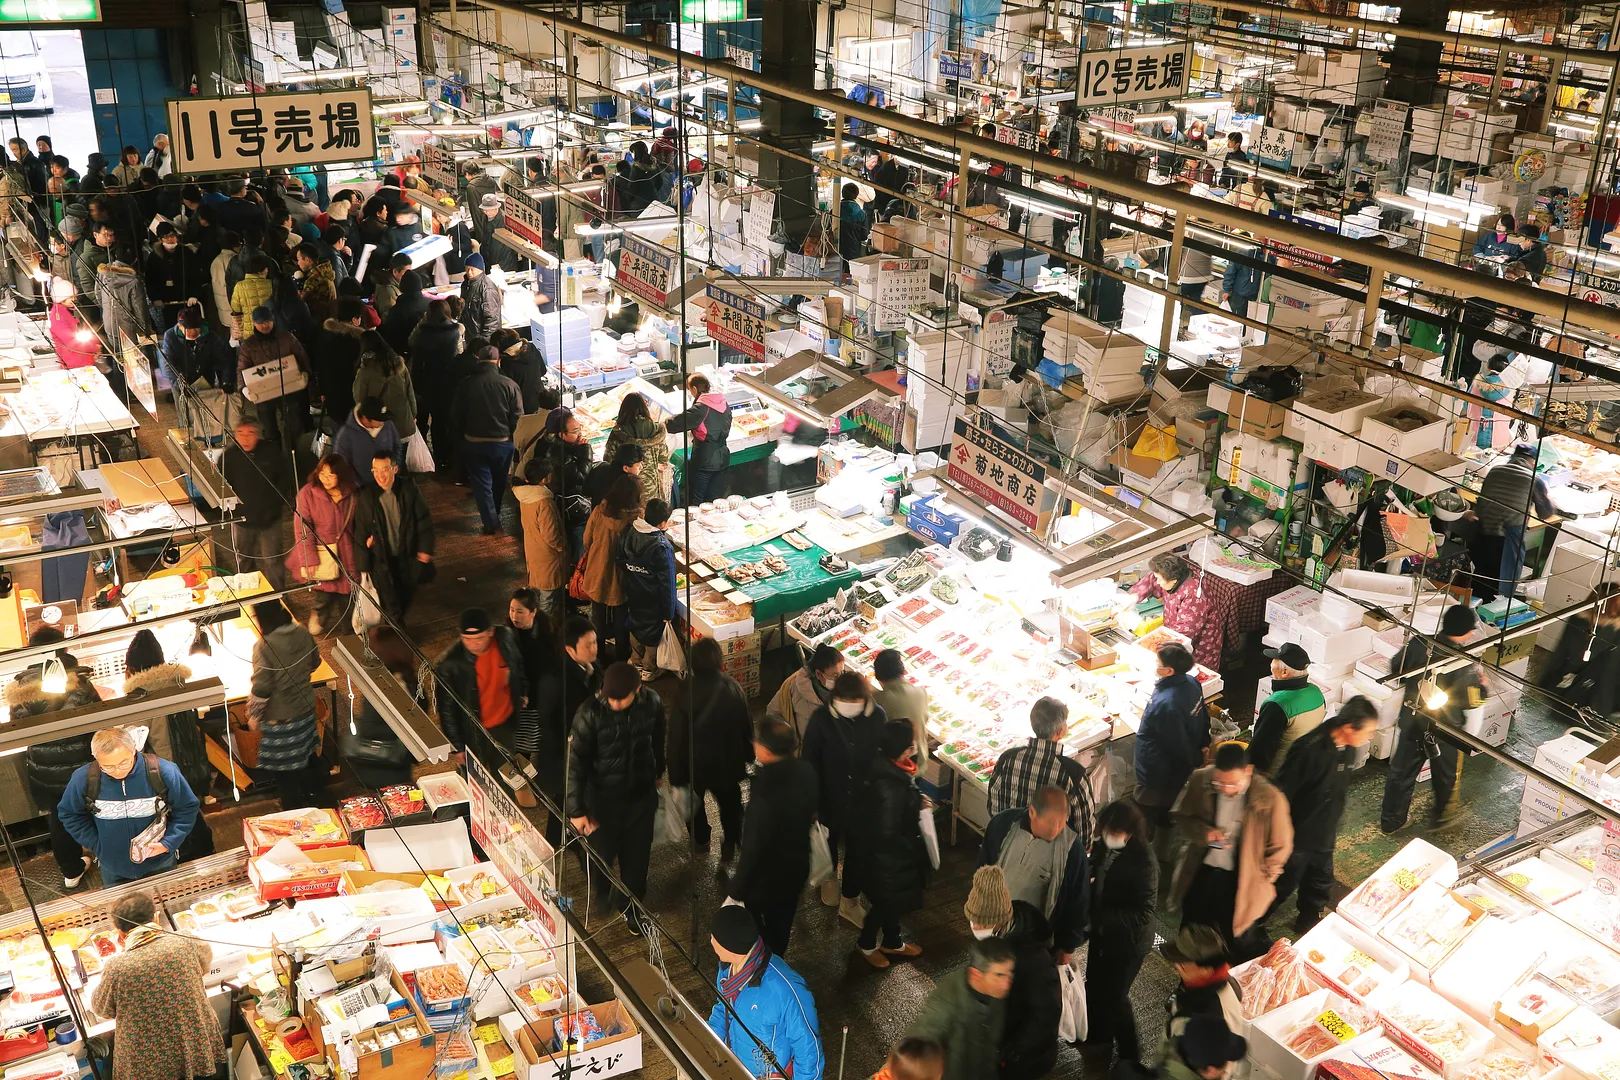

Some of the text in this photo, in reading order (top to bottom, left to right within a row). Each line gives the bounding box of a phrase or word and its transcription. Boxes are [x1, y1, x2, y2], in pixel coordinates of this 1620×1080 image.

[1083, 52, 1184, 98] 12号売場
[181, 102, 361, 161] 11号売場
[632, 258, 667, 291] 平間商店
[721, 307, 764, 343] 平間商店
[975, 453, 1037, 507] 菊地商店
[1545, 757, 1570, 773] PRODUCT
[1580, 775, 1599, 789] RUSSIA
[1534, 797, 1559, 814] PRODUCT
